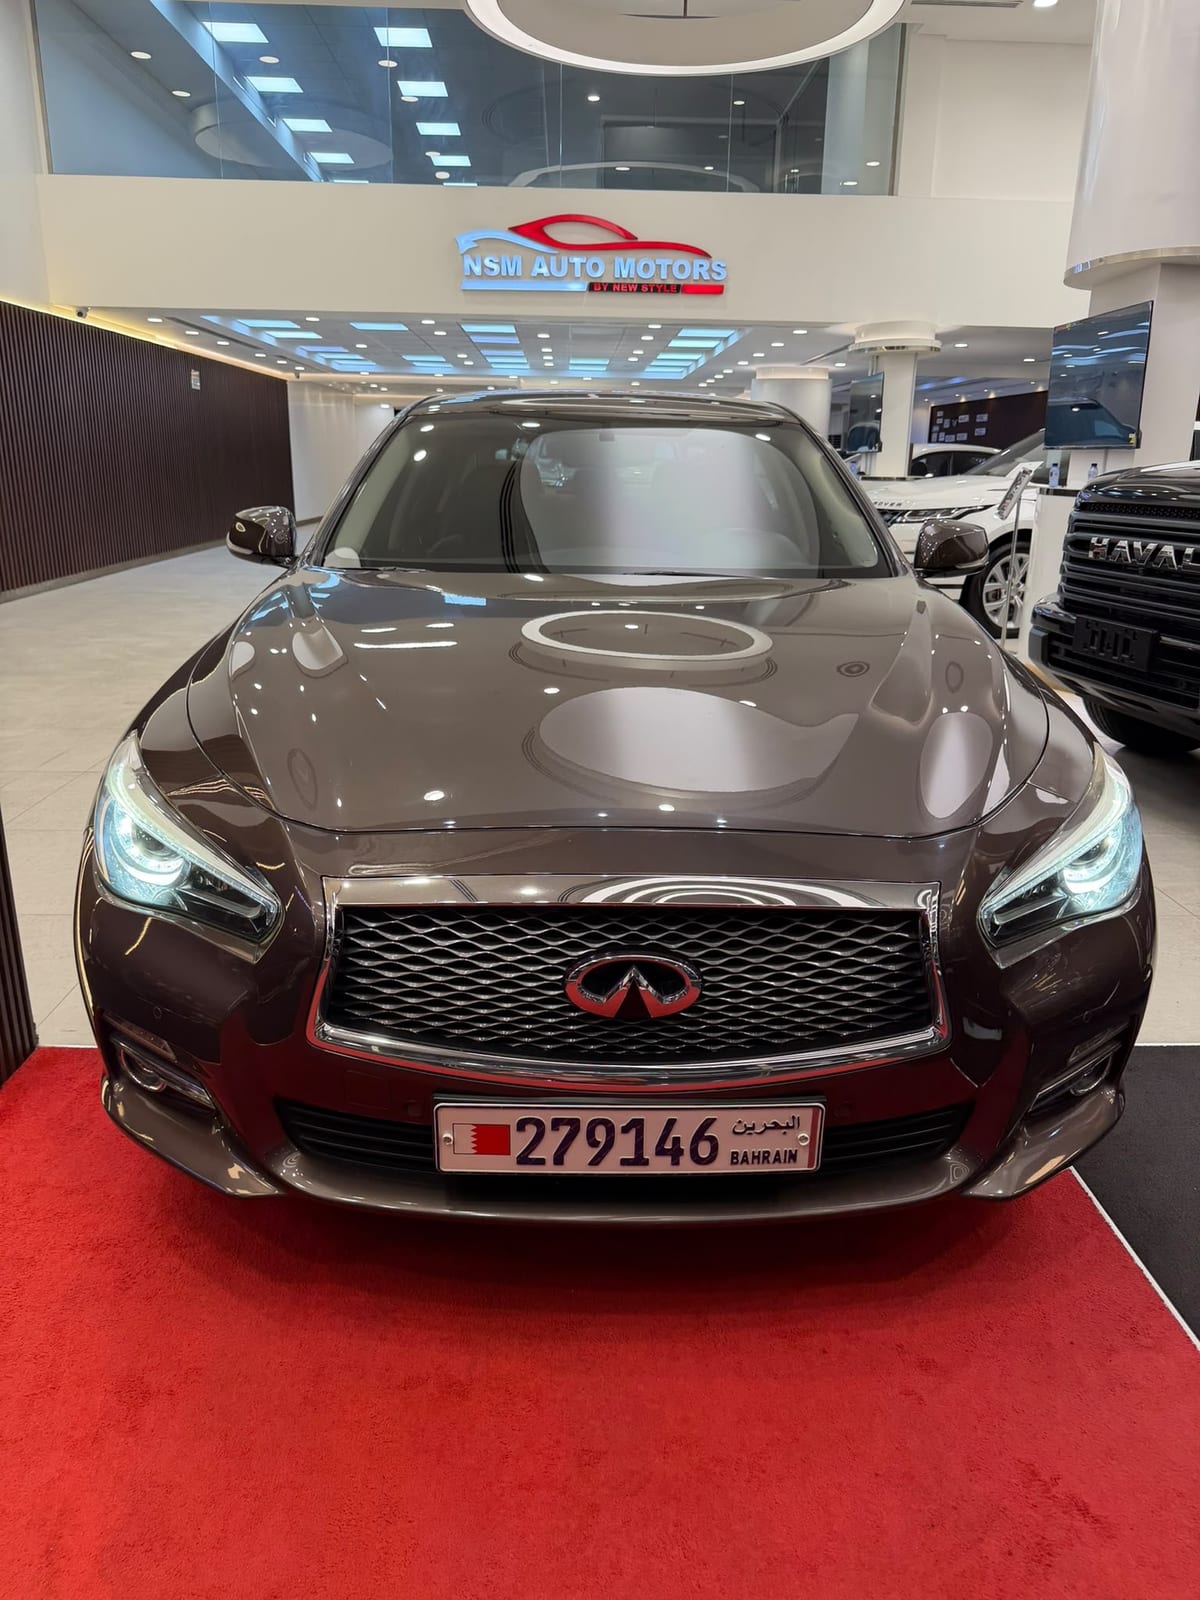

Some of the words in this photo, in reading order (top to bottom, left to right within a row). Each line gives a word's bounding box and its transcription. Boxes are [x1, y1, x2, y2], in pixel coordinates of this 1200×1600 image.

[463, 254, 522, 277] NSM
[531, 255, 605, 278] AUTO
[613, 258, 728, 281] MOTORS
[593, 282, 608, 292] BY
[612, 282, 638, 292] NEW
[641, 283, 677, 293] STYLE
[1088, 537, 1200, 573] HAVAL
[732, 1114, 800, 1135] البحرين
[515, 1117, 719, 1166] 279146
[730, 1149, 798, 1166] BAHRAIN
